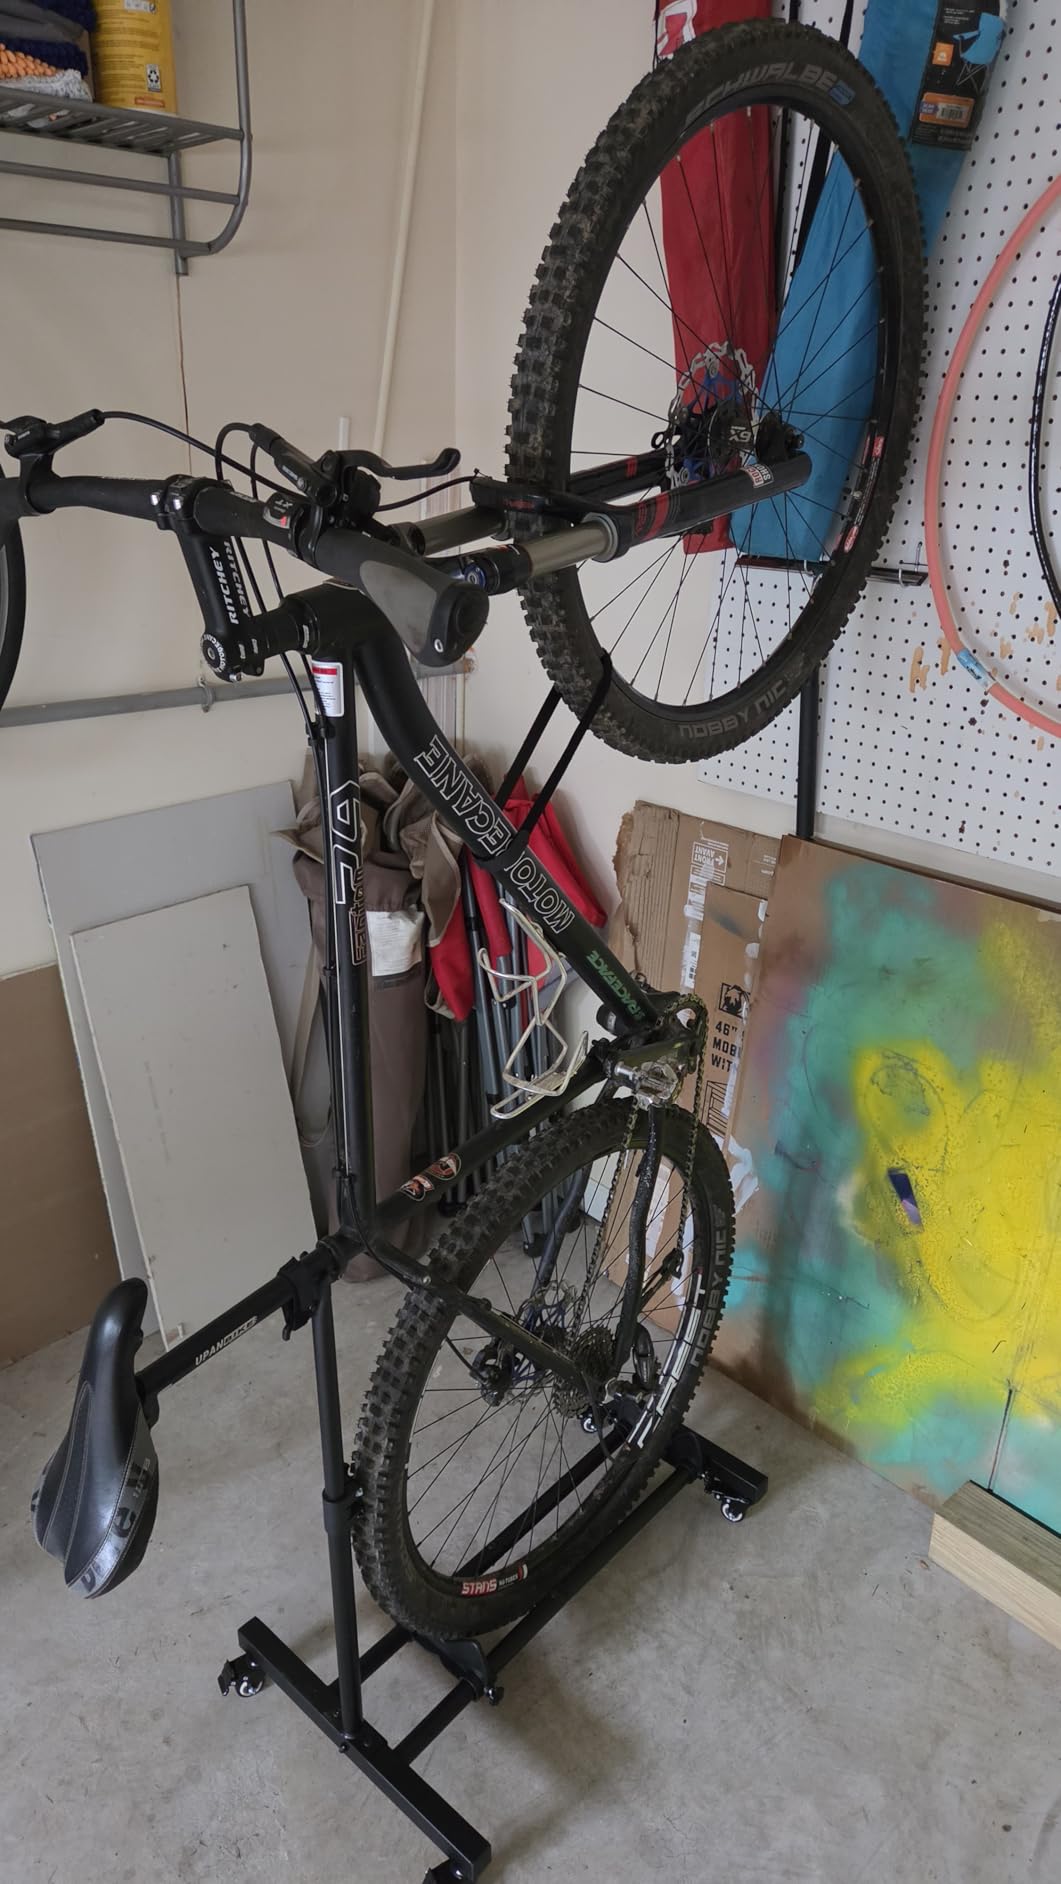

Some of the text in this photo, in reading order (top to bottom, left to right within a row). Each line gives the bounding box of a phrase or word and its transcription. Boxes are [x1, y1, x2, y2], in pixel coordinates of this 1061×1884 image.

[684, 61, 838, 127] SCHWALBE
[746, 465, 763, 485] ROC
[208, 546, 239, 625] RITCHEY
[224, 541, 251, 618] RITCHEY
[678, 679, 787, 739] NOBBY NIC
[413, 734, 576, 935] MOTOECANE
[586, 950, 641, 1015] RACEFACE
[715, 1021, 738, 1037] 46"
[690, 1230, 728, 1368] NOBBY NIC
[461, 1578, 497, 1595] STANS
